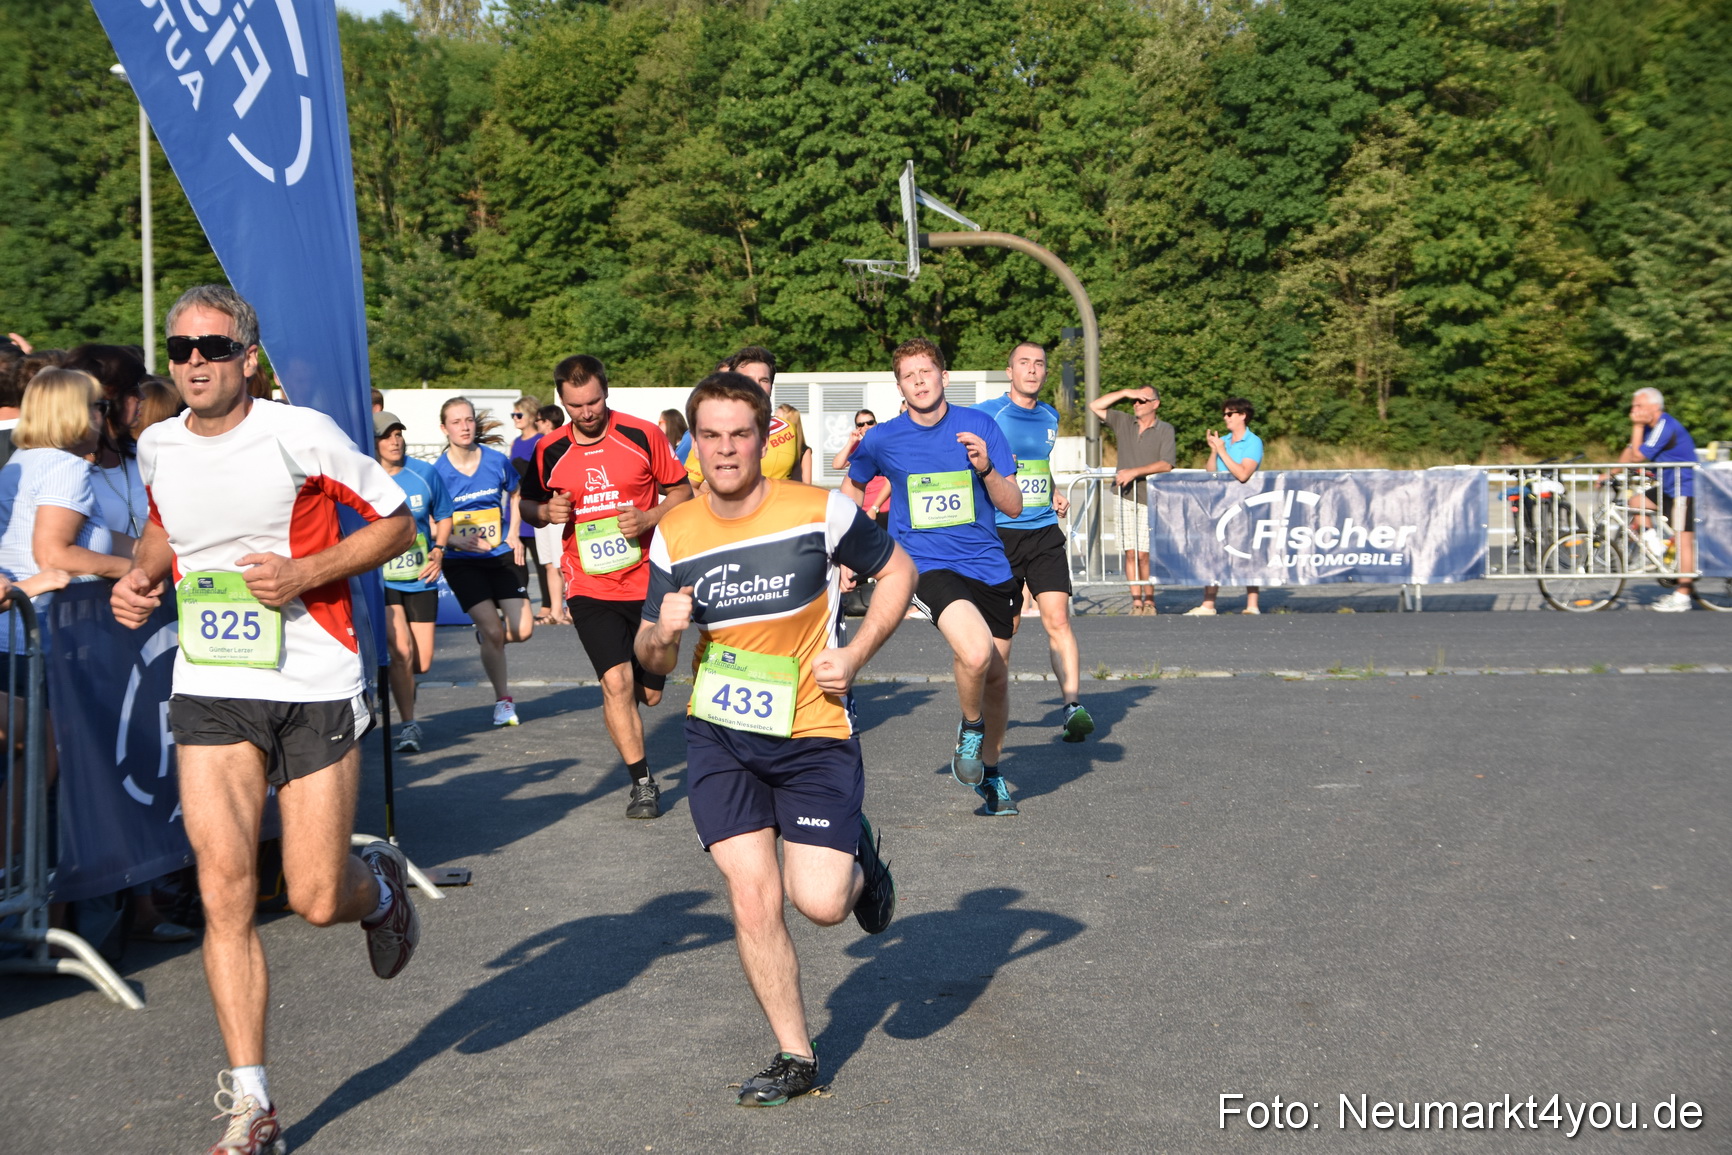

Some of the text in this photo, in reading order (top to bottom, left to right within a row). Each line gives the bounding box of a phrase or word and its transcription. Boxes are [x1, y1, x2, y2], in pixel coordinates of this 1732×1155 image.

[770, 431, 796, 448] BÖGL
[583, 490, 619, 505] MEYER
[922, 493, 961, 513] 736
[574, 500, 616, 515] ördertechnik
[1252, 517, 1418, 550] Fischer
[590, 537, 628, 560] 968
[1267, 552, 1405, 568] AUTOMOBILE
[708, 572, 796, 601] Fischer
[715, 589, 790, 609] AUTOMOBILE
[201, 609, 261, 640] 825
[714, 659, 748, 673] firmenlauf
[712, 683, 773, 718] 433
[707, 714, 736, 725] Sebastian
[796, 816, 830, 828] JAKO
